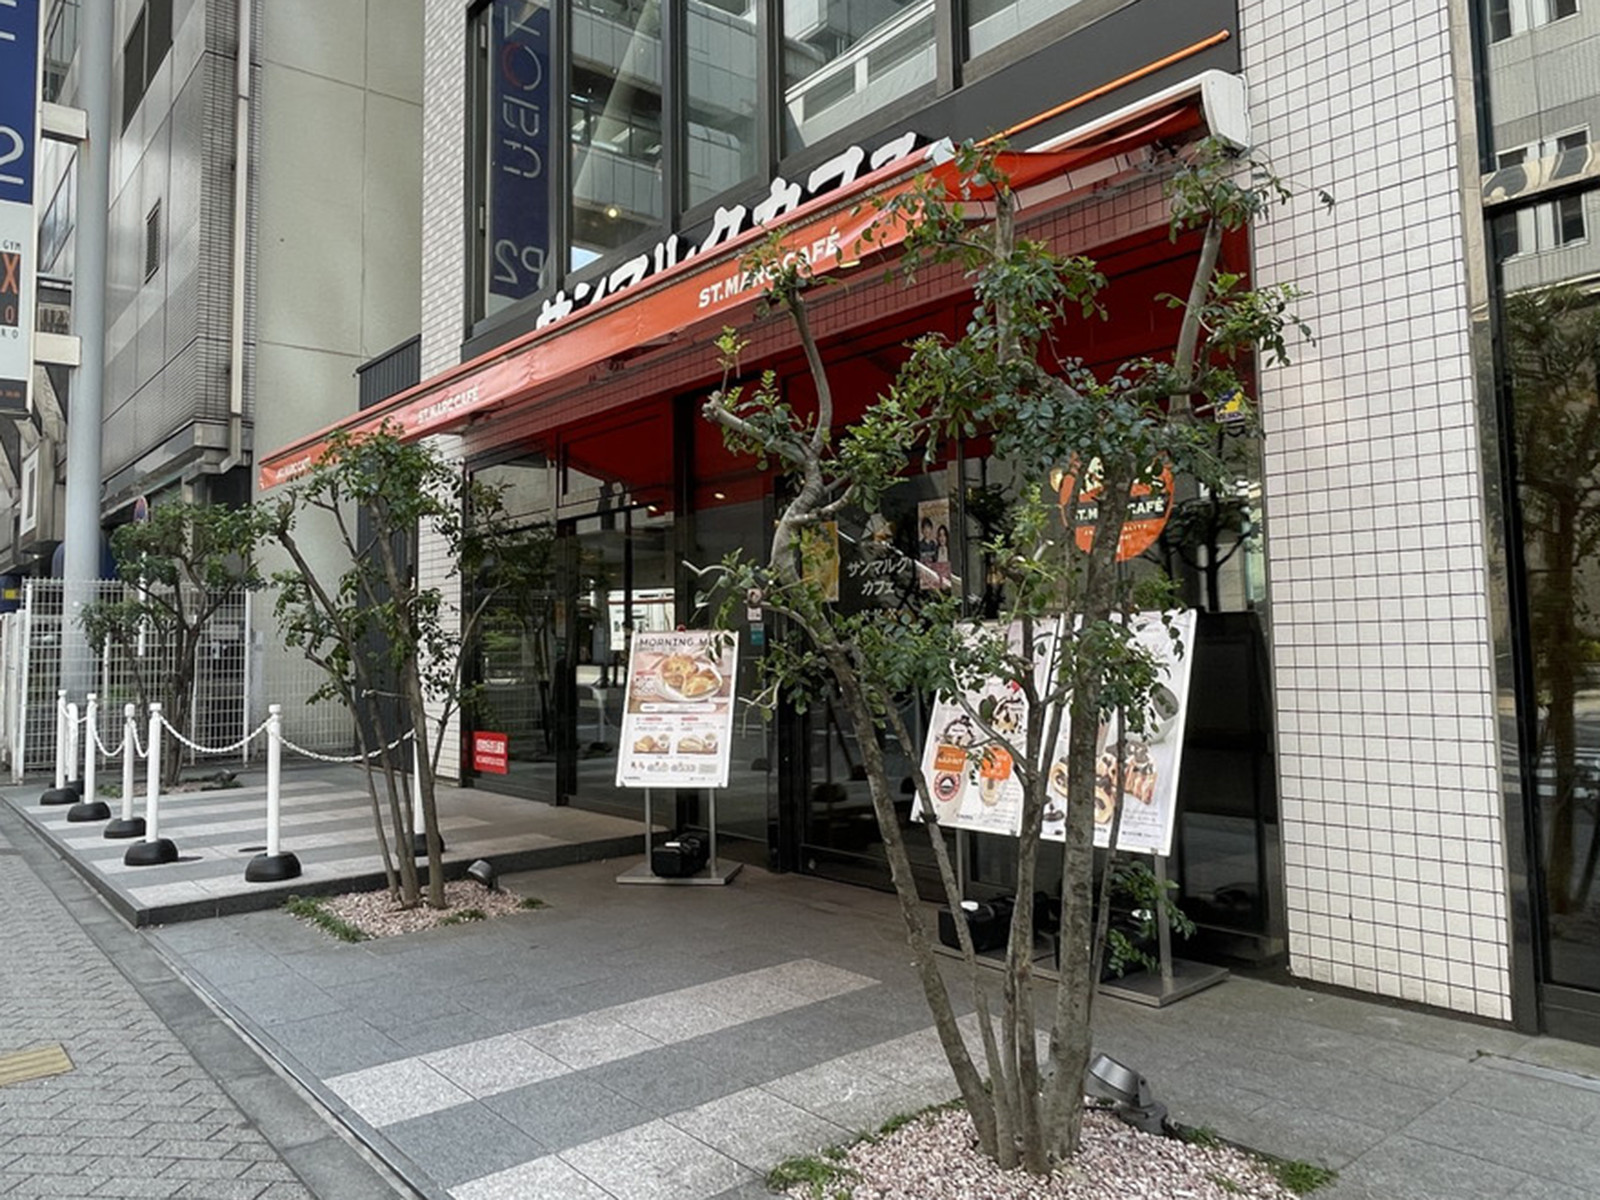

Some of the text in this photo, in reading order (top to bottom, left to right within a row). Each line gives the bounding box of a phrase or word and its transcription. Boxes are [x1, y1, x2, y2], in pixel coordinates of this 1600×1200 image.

[847, 556, 908, 578] サンマルク
[861, 580, 896, 597] カフェ
[639, 637, 694, 648] MORNING
